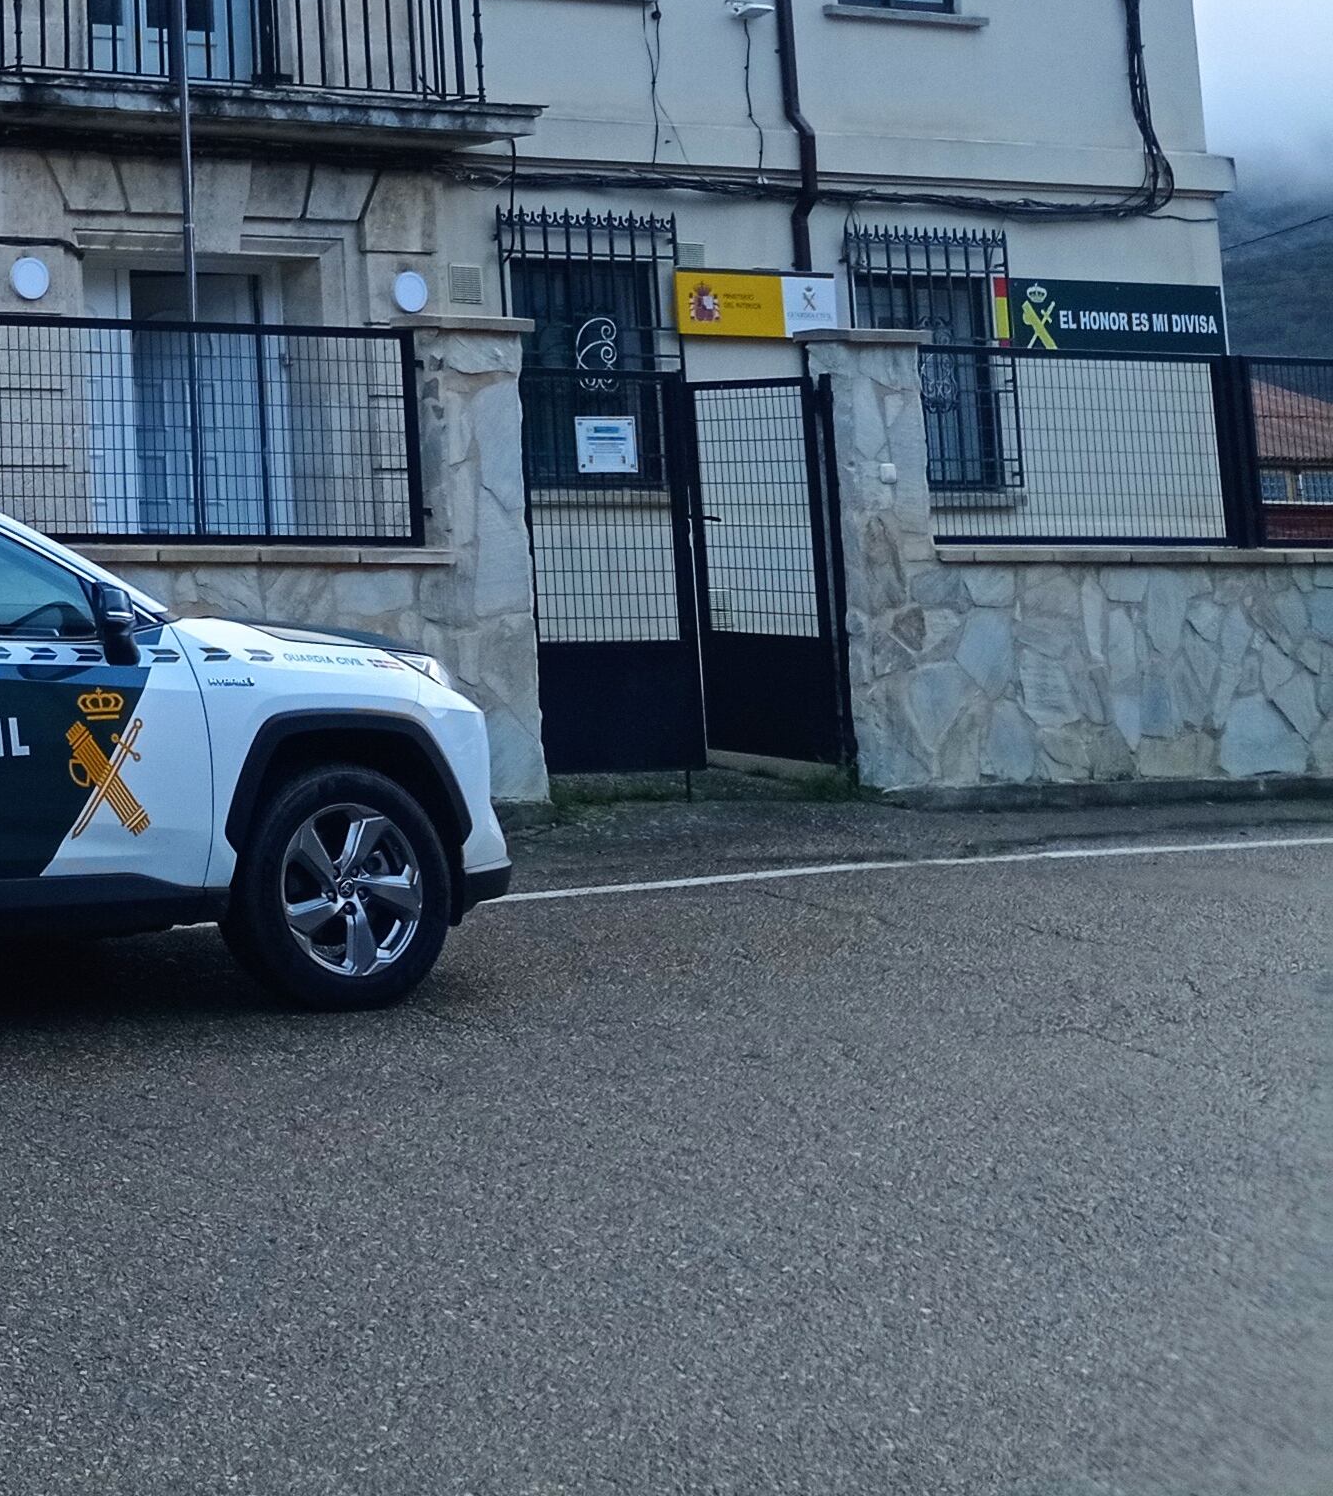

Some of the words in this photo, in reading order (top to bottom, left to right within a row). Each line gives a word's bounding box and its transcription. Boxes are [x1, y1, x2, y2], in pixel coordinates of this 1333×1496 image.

[1059, 310, 1077, 330] EL
[1080, 310, 1130, 331] HONOR
[1132, 312, 1150, 332] ES
[1152, 313, 1169, 333] MI
[1172, 314, 1218, 335] DIVISA
[283, 653, 335, 665] GUARDIA
[336, 655, 364, 667] CIVIL
